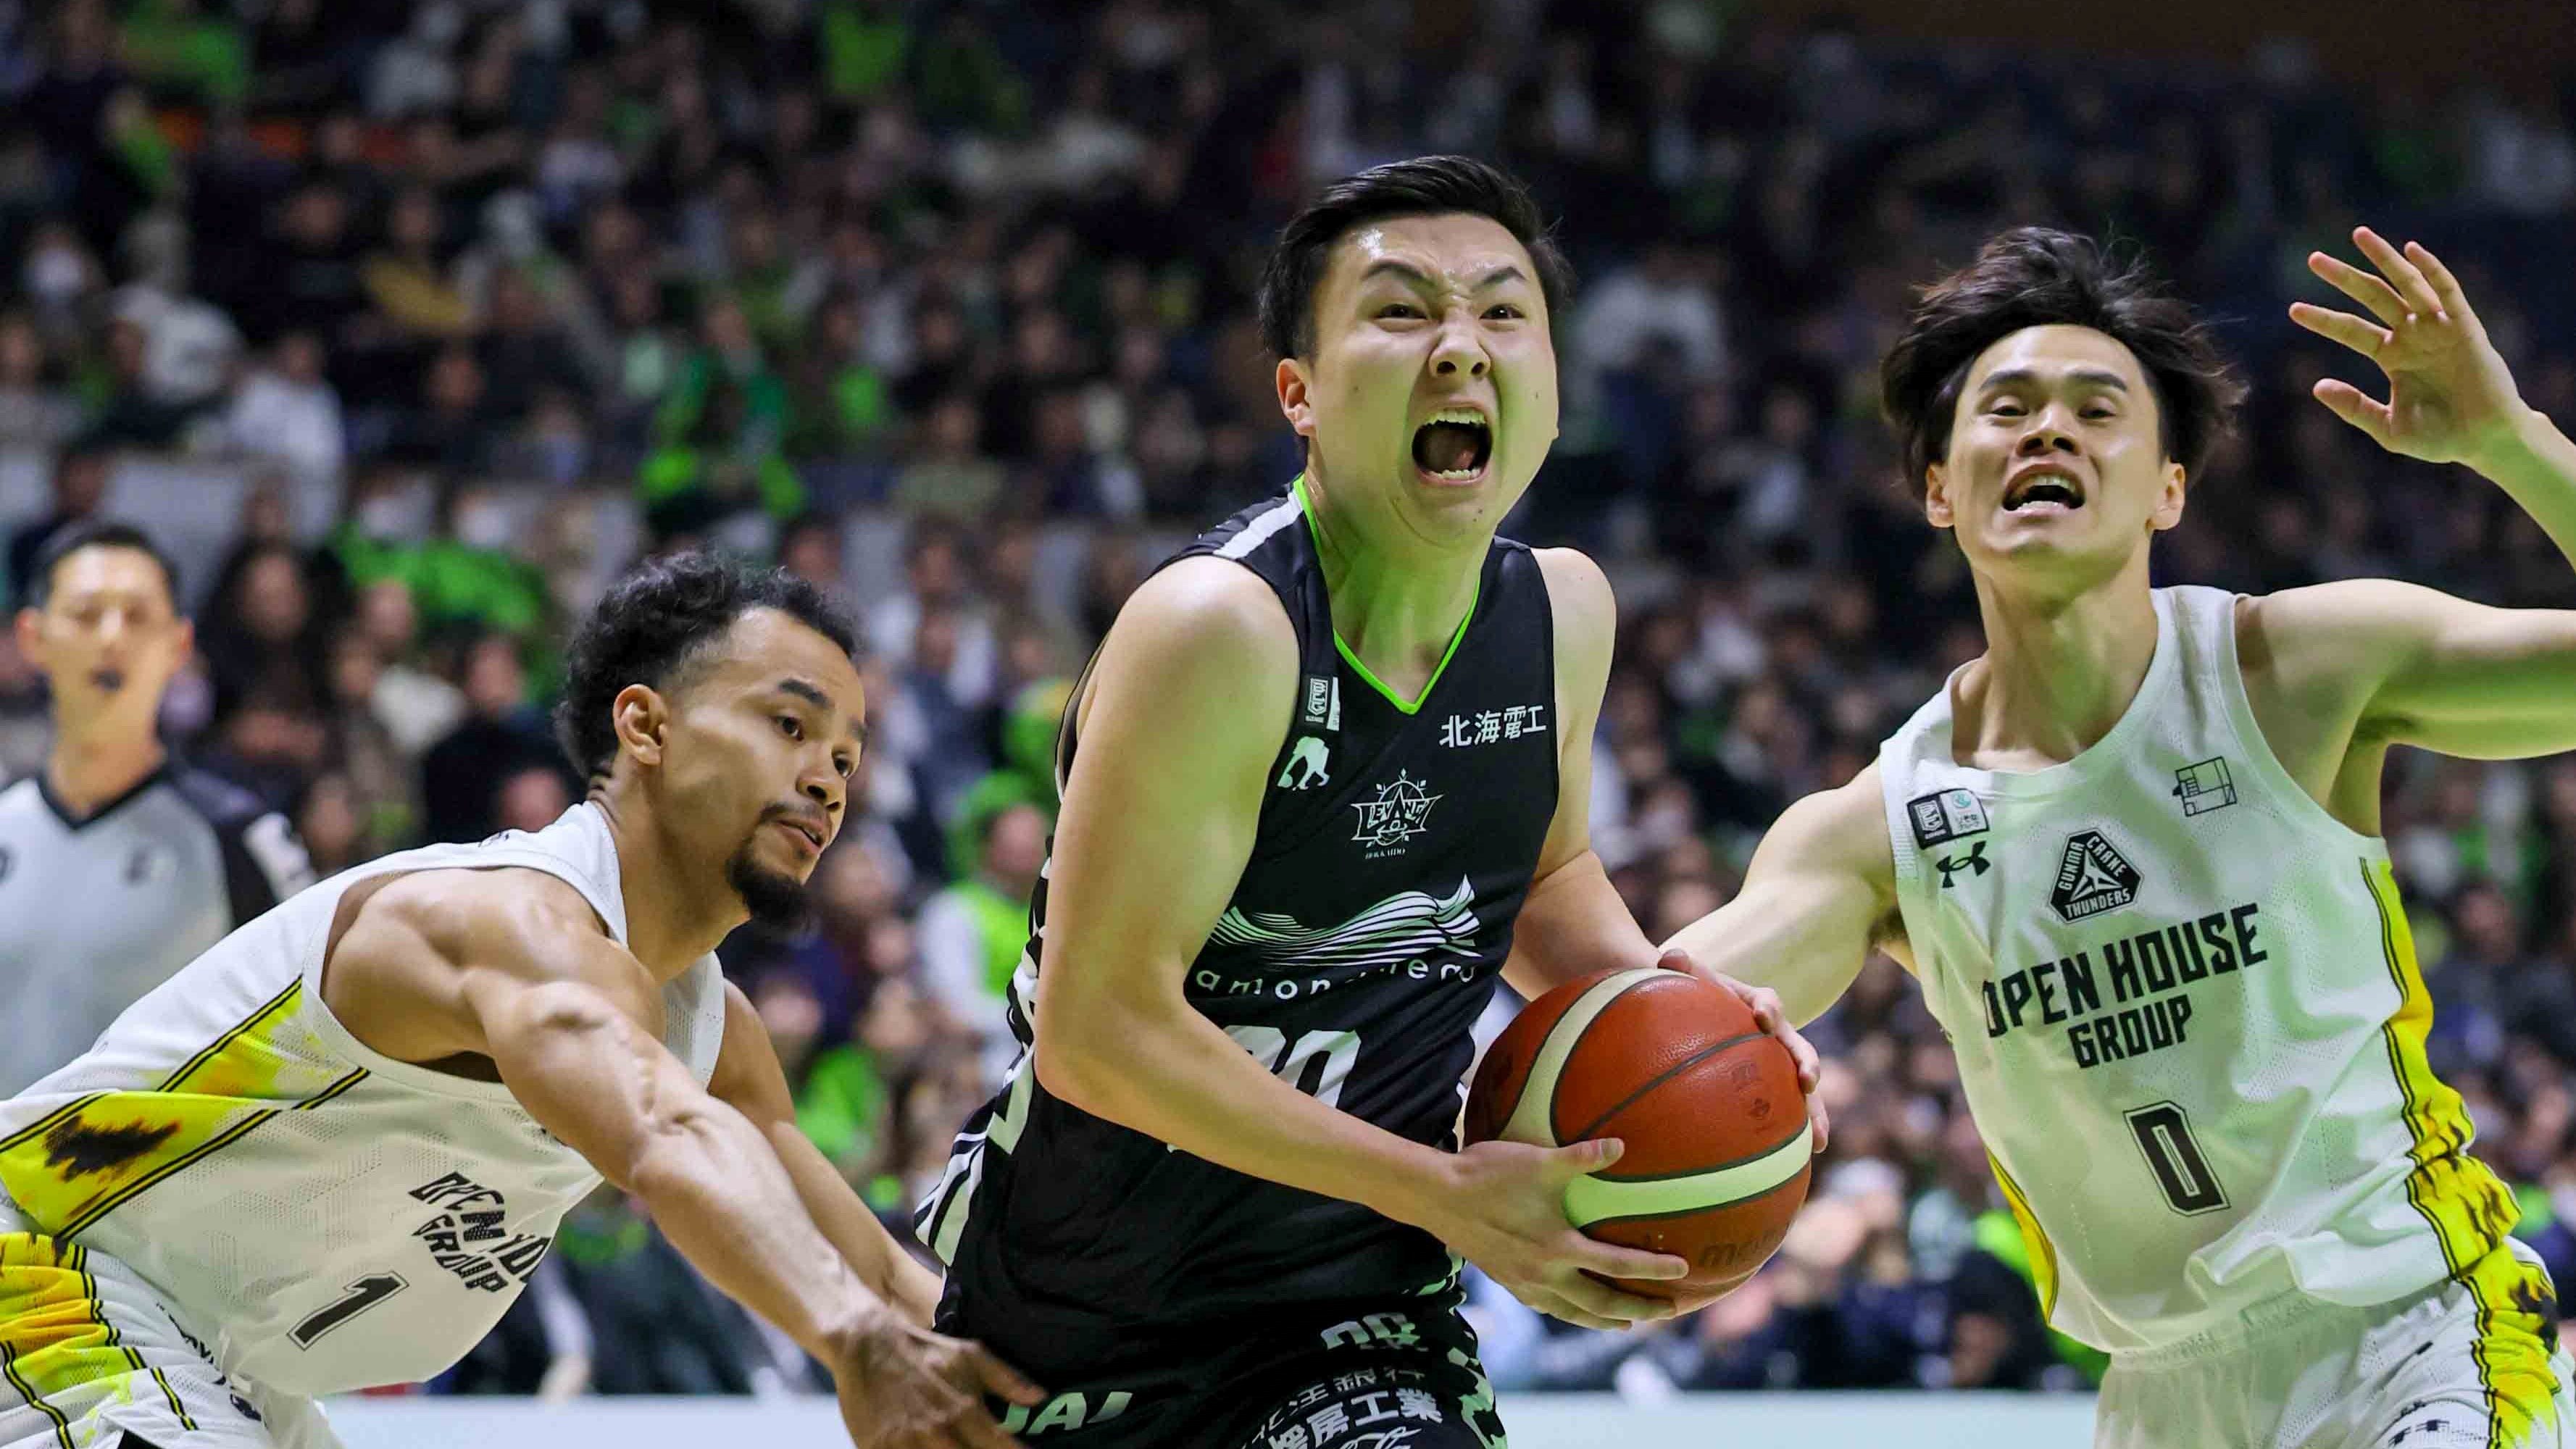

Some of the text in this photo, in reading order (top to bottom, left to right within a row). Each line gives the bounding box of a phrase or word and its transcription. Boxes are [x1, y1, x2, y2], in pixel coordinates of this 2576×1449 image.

[1438, 705, 1548, 748] 北海電工
[2057, 841, 2085, 891] GUNMA
[2086, 835, 2127, 877] CRANE
[2064, 888, 2131, 919] THUNDERS
[1982, 902, 2268, 1038] OPEN HOUSE
[2067, 994, 2192, 1069] GROUP
[2122, 1100, 2232, 1216] 0
[412, 1214, 509, 1293] GROUP
[285, 1271, 410, 1352] 1
